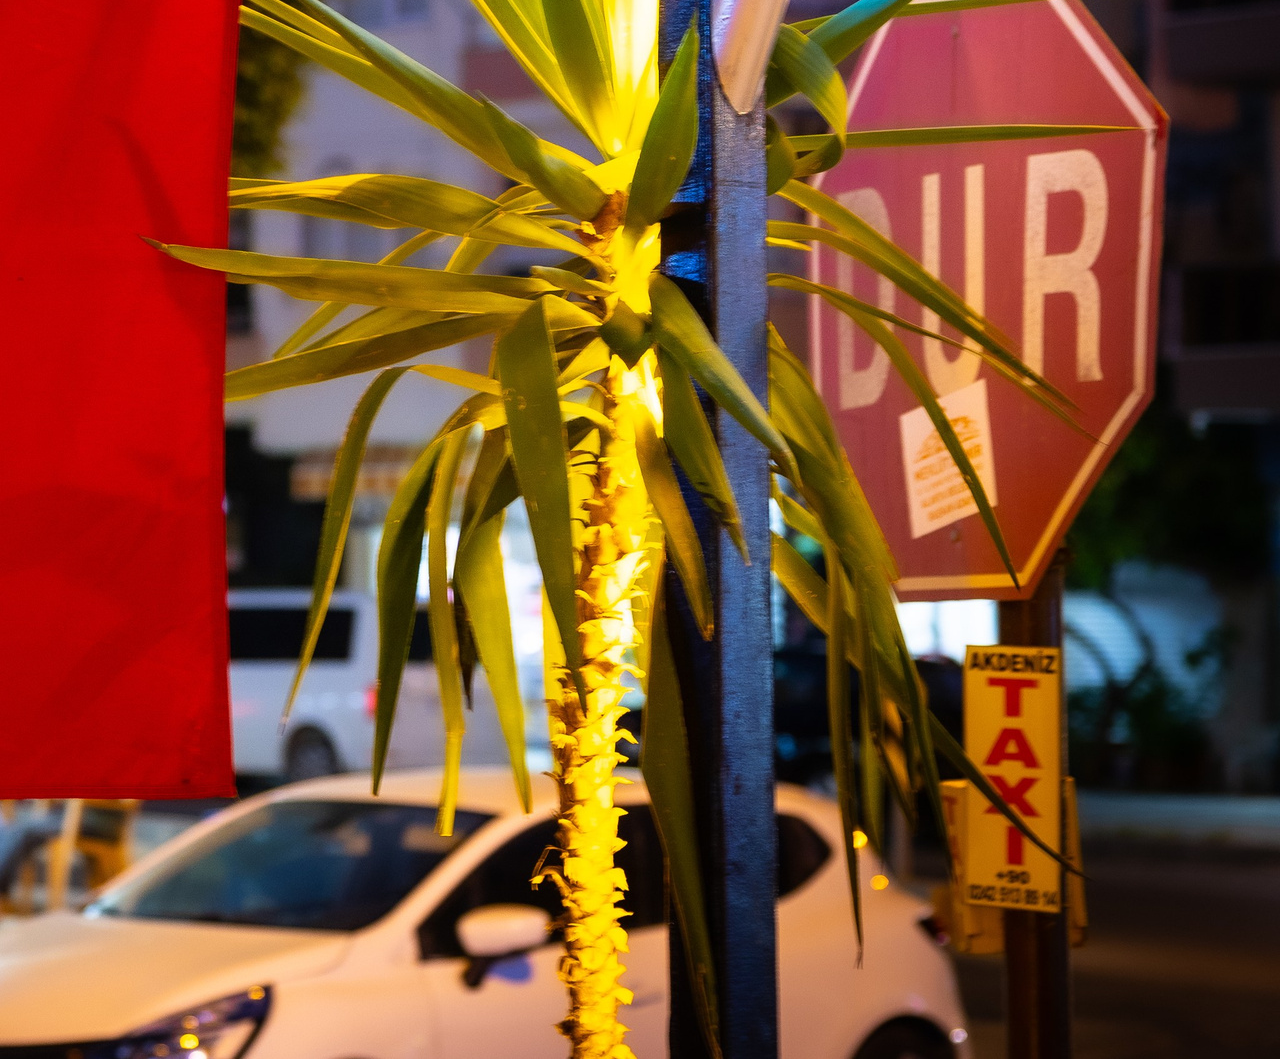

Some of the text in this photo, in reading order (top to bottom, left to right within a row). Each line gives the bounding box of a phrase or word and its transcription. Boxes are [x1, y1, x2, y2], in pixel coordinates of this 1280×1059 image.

[837, 149, 1108, 410] DUR
[970, 651, 1057, 674] AKDENİZ
[983, 677, 1042, 866] TAXI
